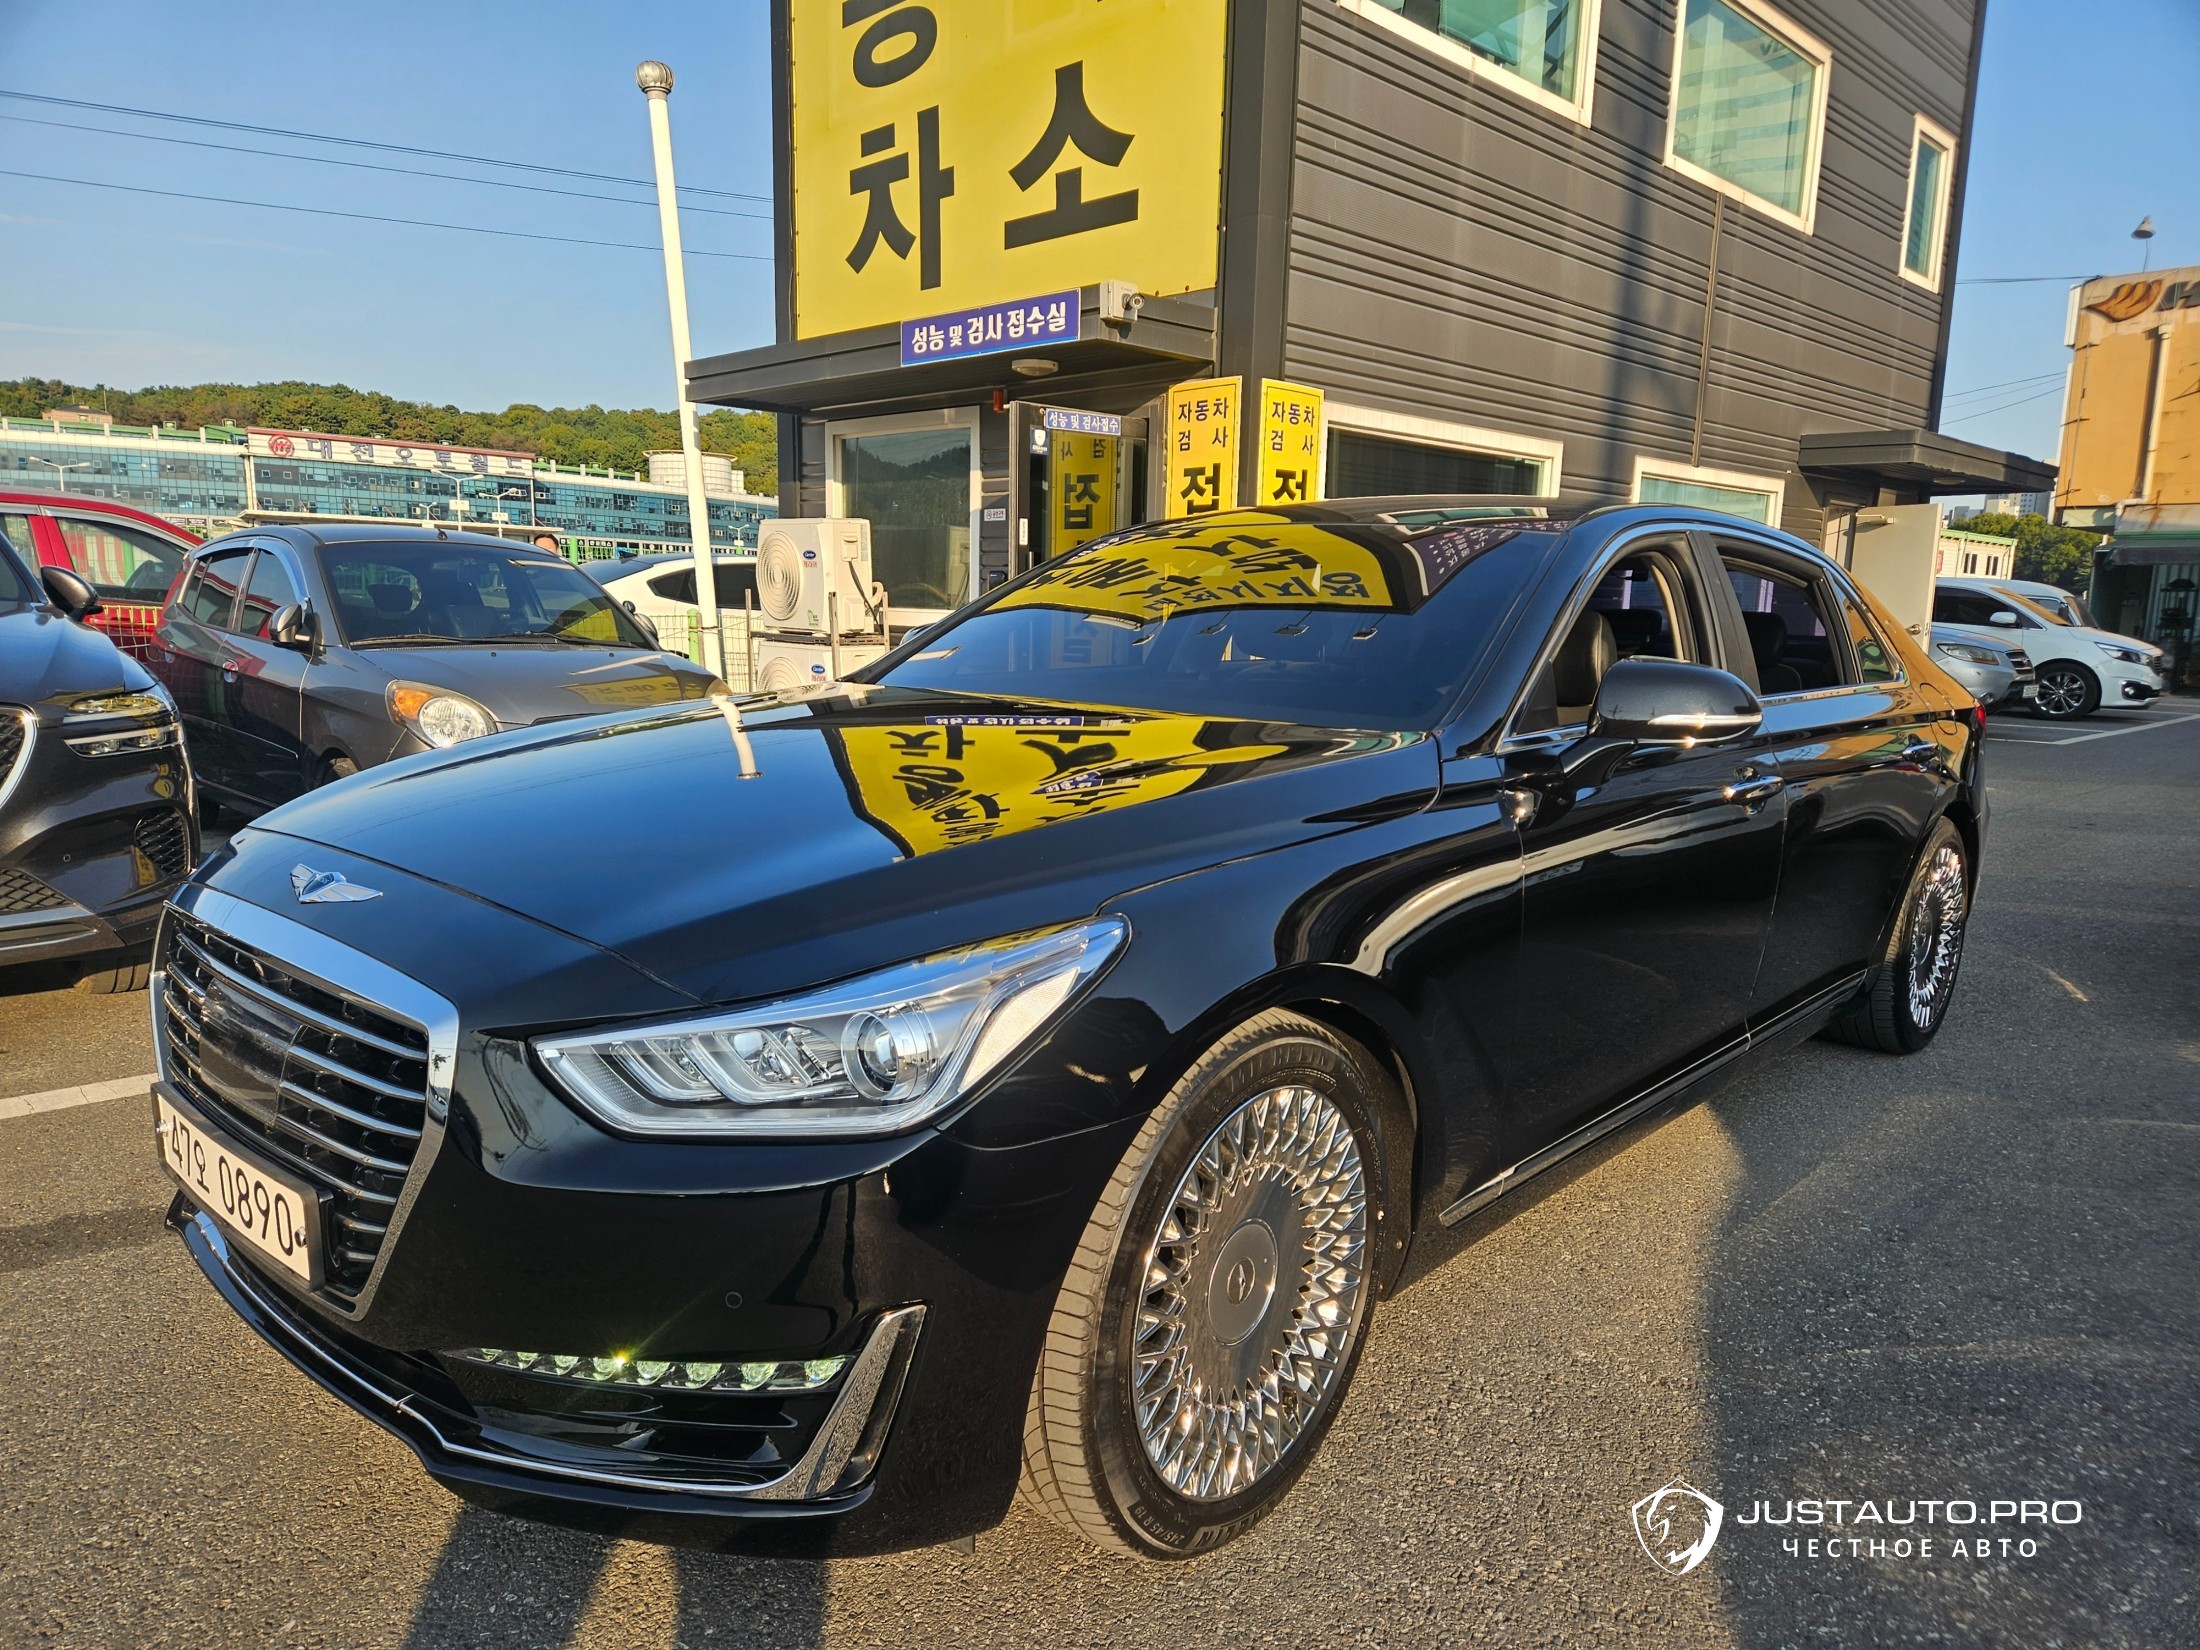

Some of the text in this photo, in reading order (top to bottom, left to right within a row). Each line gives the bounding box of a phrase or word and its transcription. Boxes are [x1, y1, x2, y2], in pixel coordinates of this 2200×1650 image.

[912, 302, 1067, 353] 성능 및 검사 접수실
[1049, 412, 1068, 428] 성능
[1070, 414, 1080, 430] 및
[1178, 397, 1229, 423] 자동차
[1271, 401, 1315, 428] 자동차
[171, 1115, 294, 1256] 47오 0890
